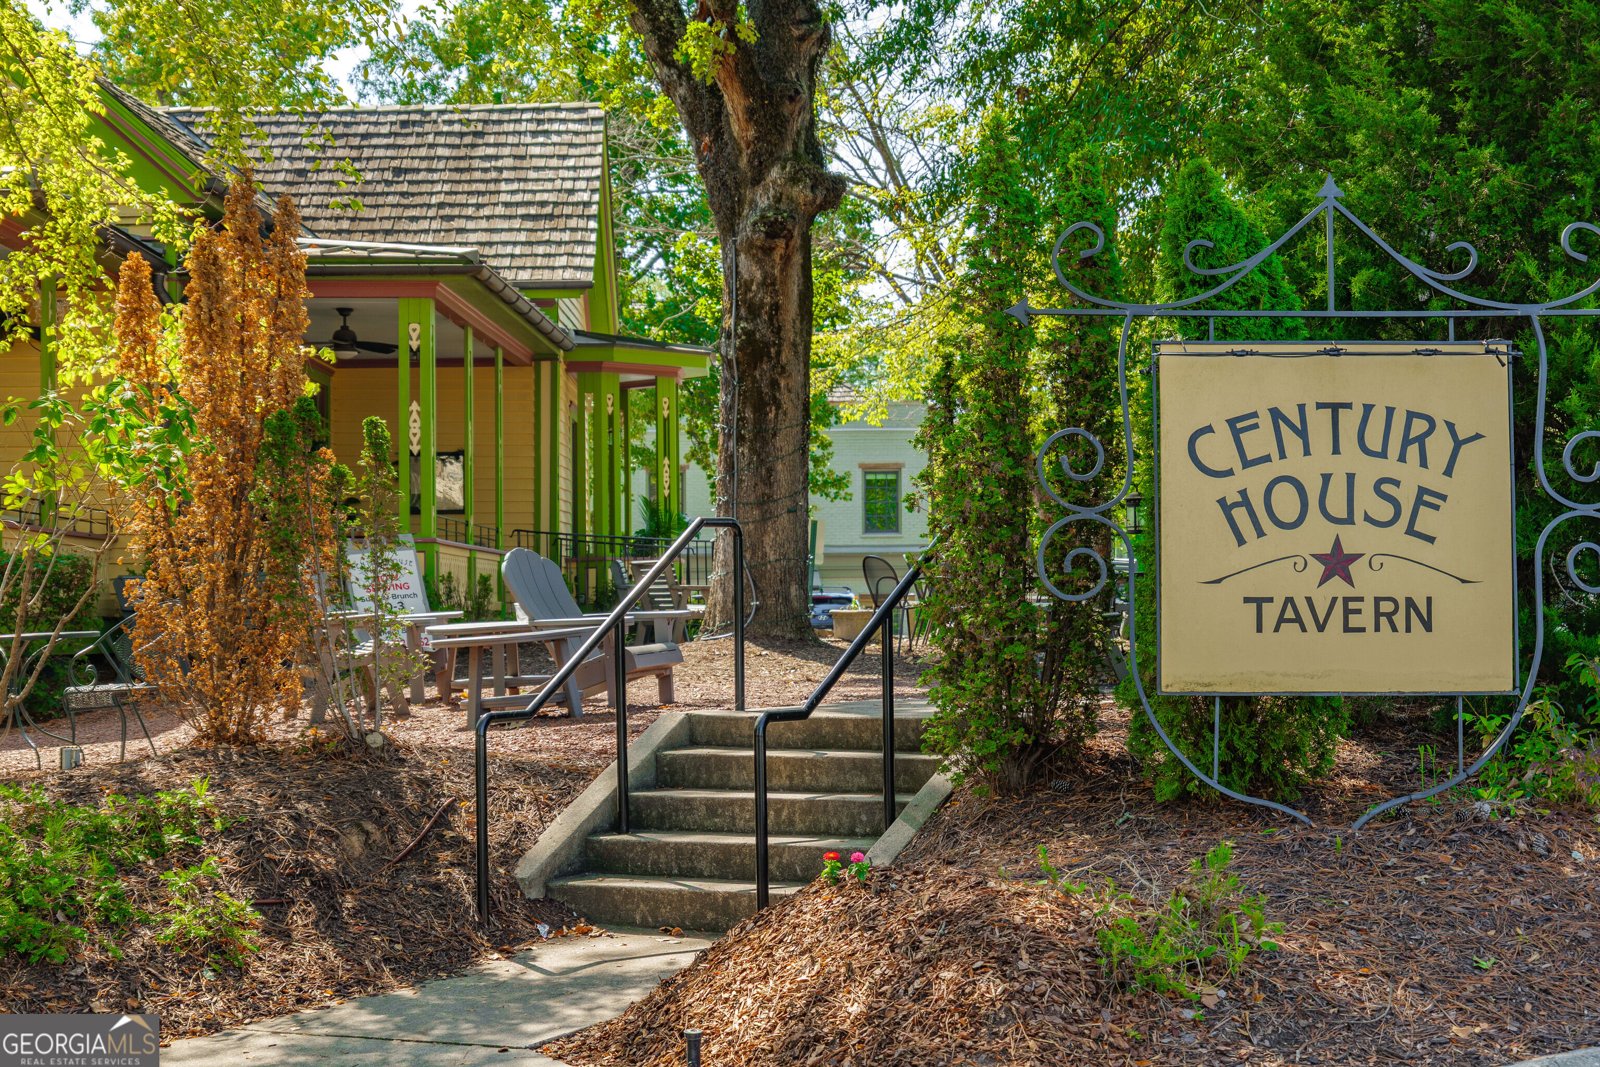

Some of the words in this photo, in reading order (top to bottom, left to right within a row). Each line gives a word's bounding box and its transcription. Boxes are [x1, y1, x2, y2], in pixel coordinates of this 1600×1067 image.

[1187, 401, 1487, 479] CENTURY
[1216, 472, 1449, 548] HOUSE
[366, 582, 410, 593] SEVING
[391, 592, 418, 600] Brunch
[1243, 595, 1433, 634] TAVERN
